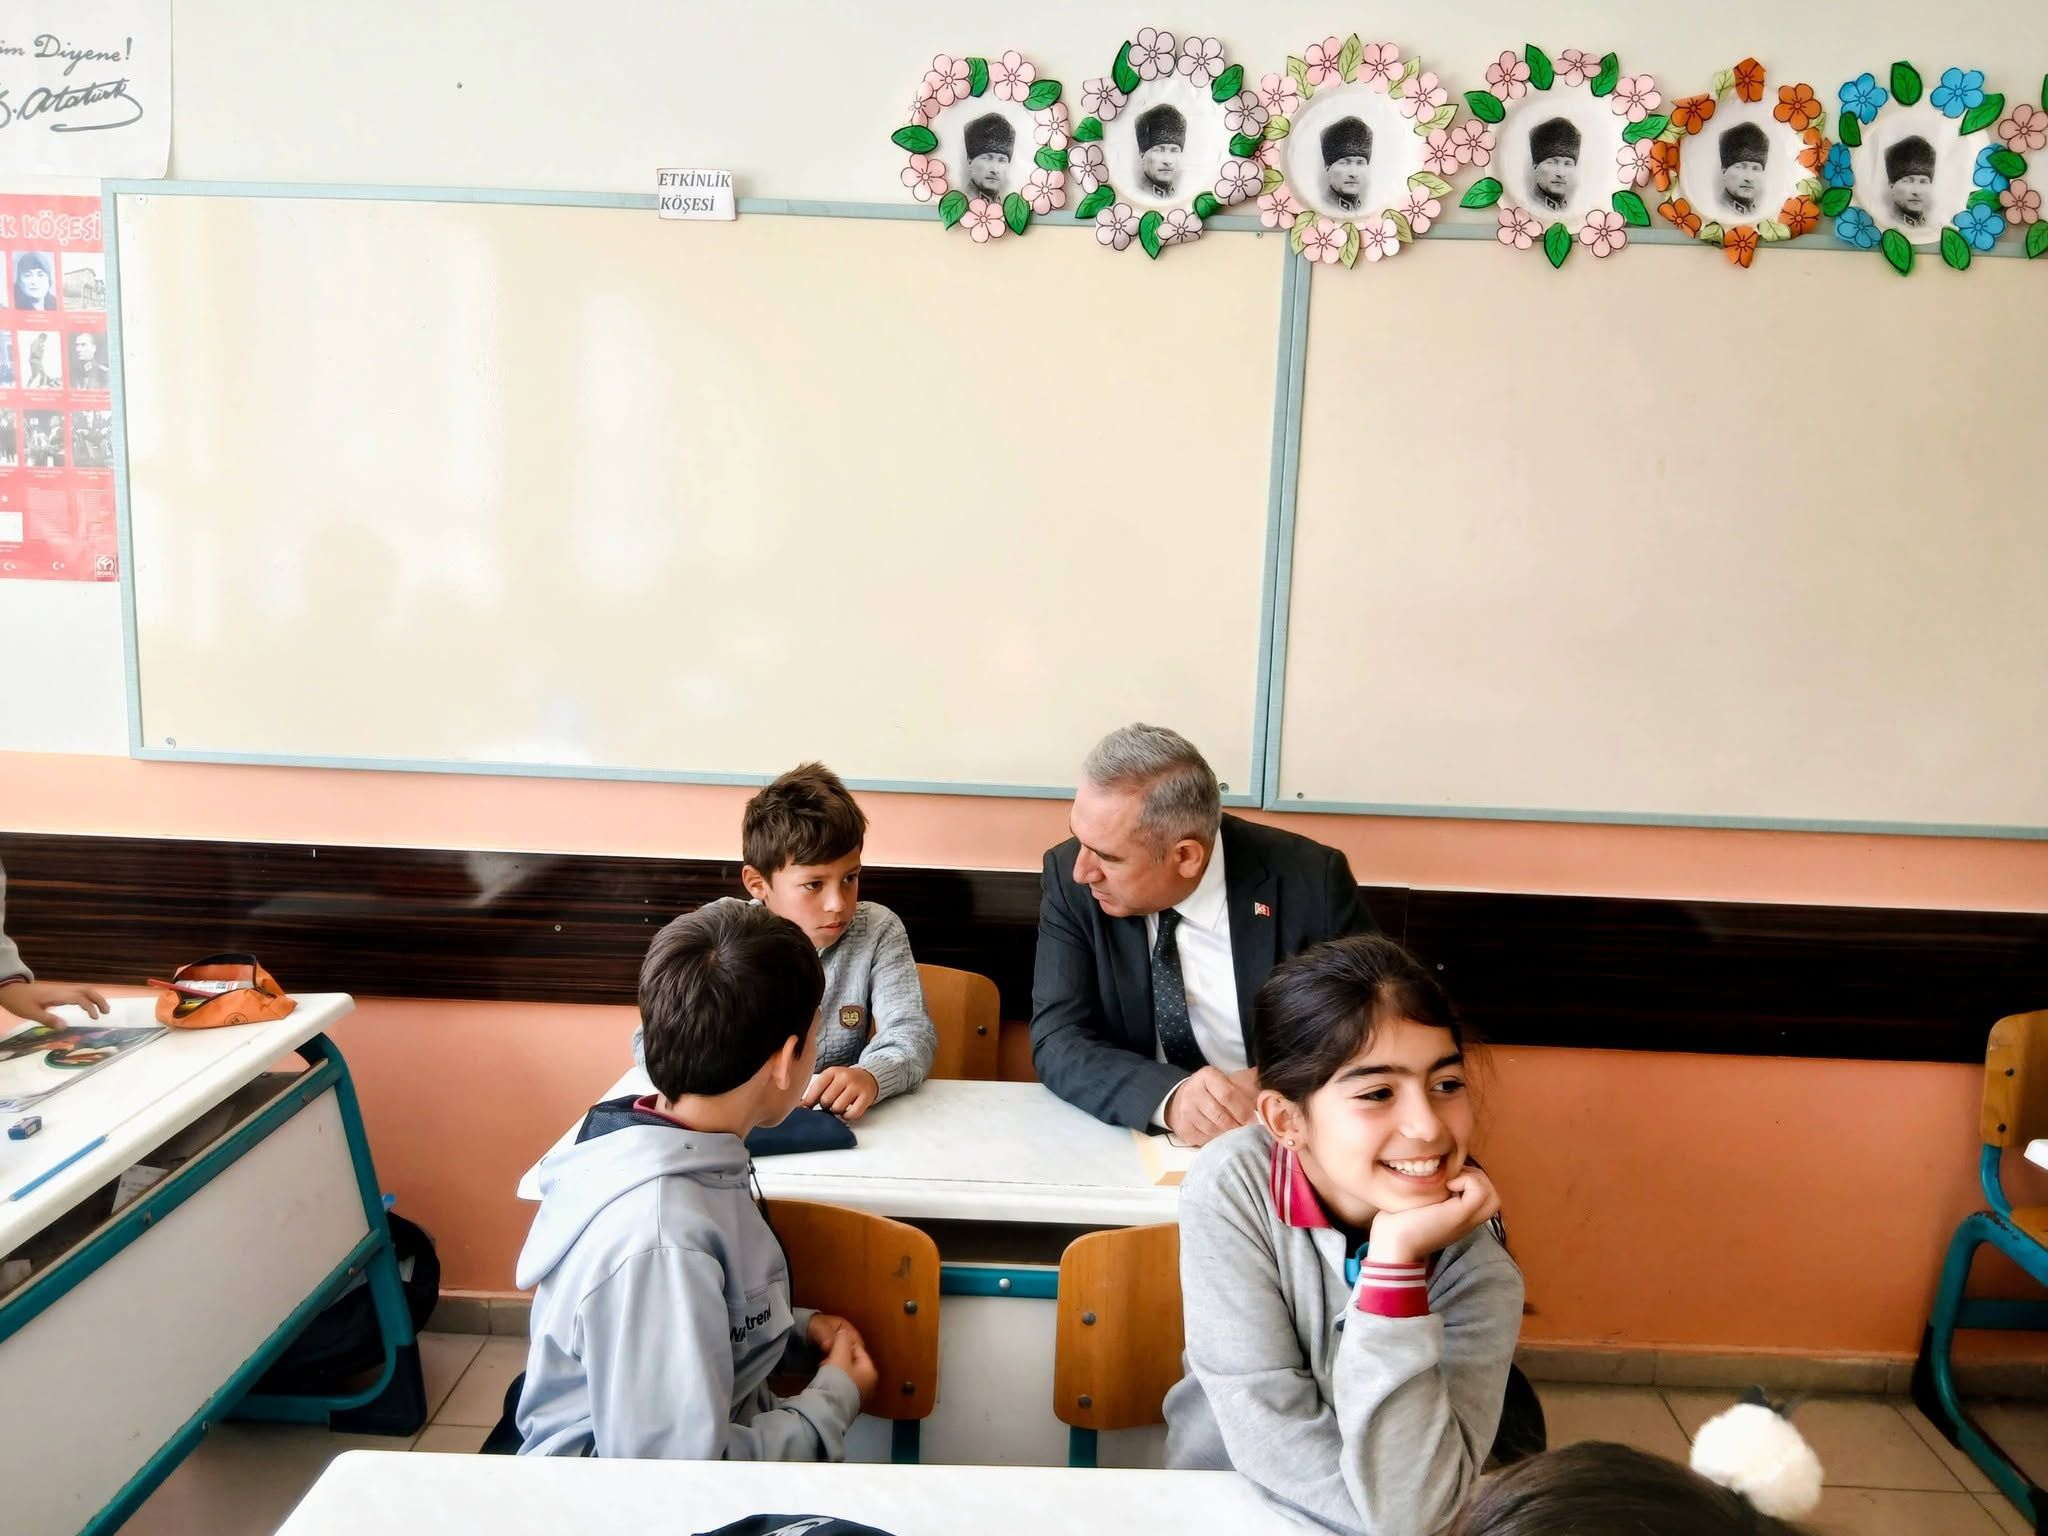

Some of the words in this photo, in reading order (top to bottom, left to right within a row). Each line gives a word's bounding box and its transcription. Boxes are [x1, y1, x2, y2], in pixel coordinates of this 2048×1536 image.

[34, 34, 132, 76] Diyene!
[659, 171, 731, 187] ETKİNLİK
[660, 195, 715, 214] KÖŞESİ
[23, 210, 102, 246] KÖŞESİ
